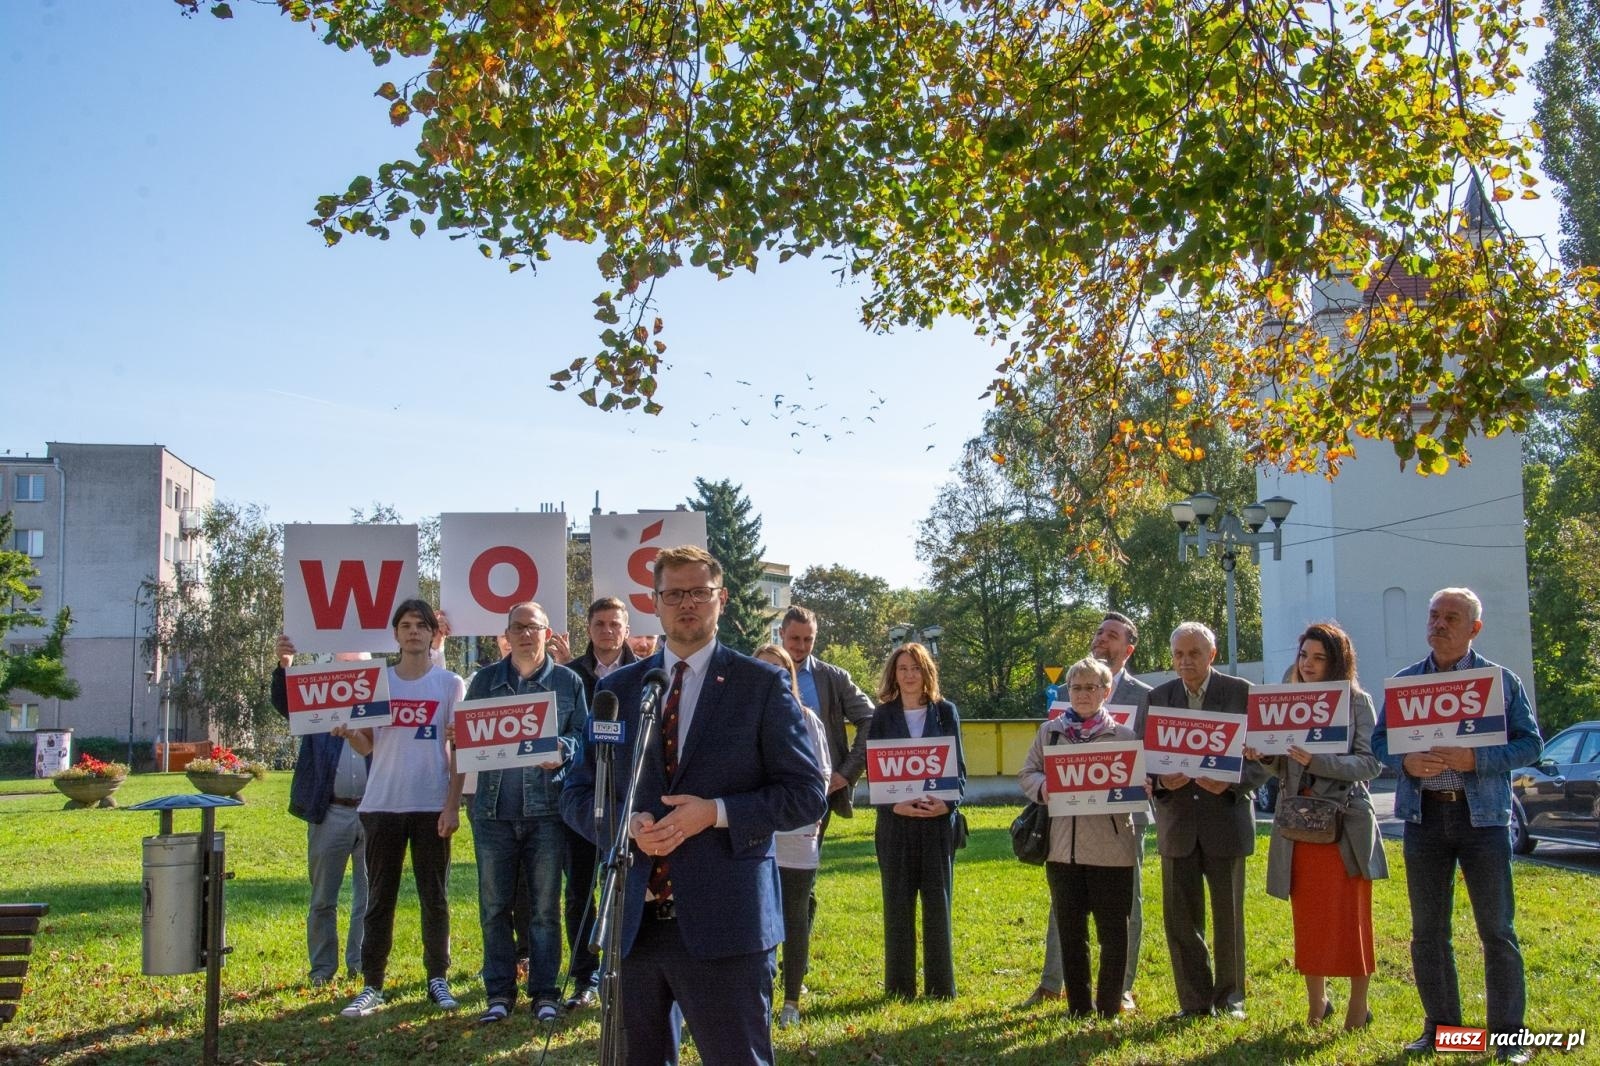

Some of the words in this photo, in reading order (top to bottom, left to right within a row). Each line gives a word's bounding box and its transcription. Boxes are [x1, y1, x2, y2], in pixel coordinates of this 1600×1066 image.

[299, 560, 404, 630] W
[469, 545, 539, 614] O
[310, 675, 331, 683] SEJMU
[298, 670, 371, 706] WOŚ
[1410, 687, 1434, 696] SEJMU
[1398, 681, 1481, 721] WOŚ
[357, 704, 366, 716] 3
[465, 712, 476, 720] DO
[477, 710, 499, 718] SEJMU
[1258, 692, 1330, 726] WOŚ
[466, 704, 539, 742] WOŚ
[1168, 719, 1190, 727] SEJMU
[1465, 720, 1475, 733] 3
[424, 726, 432, 738] 3
[1157, 723, 1227, 752] WOŚ
[1313, 728, 1322, 740] 3
[524, 740, 533, 752] 3
[878, 747, 942, 777] WOŚ
[1207, 756, 1217, 767] 3
[1056, 752, 1128, 787] WOŚ
[928, 778, 937, 789] 3
[1114, 788, 1123, 800] 3
